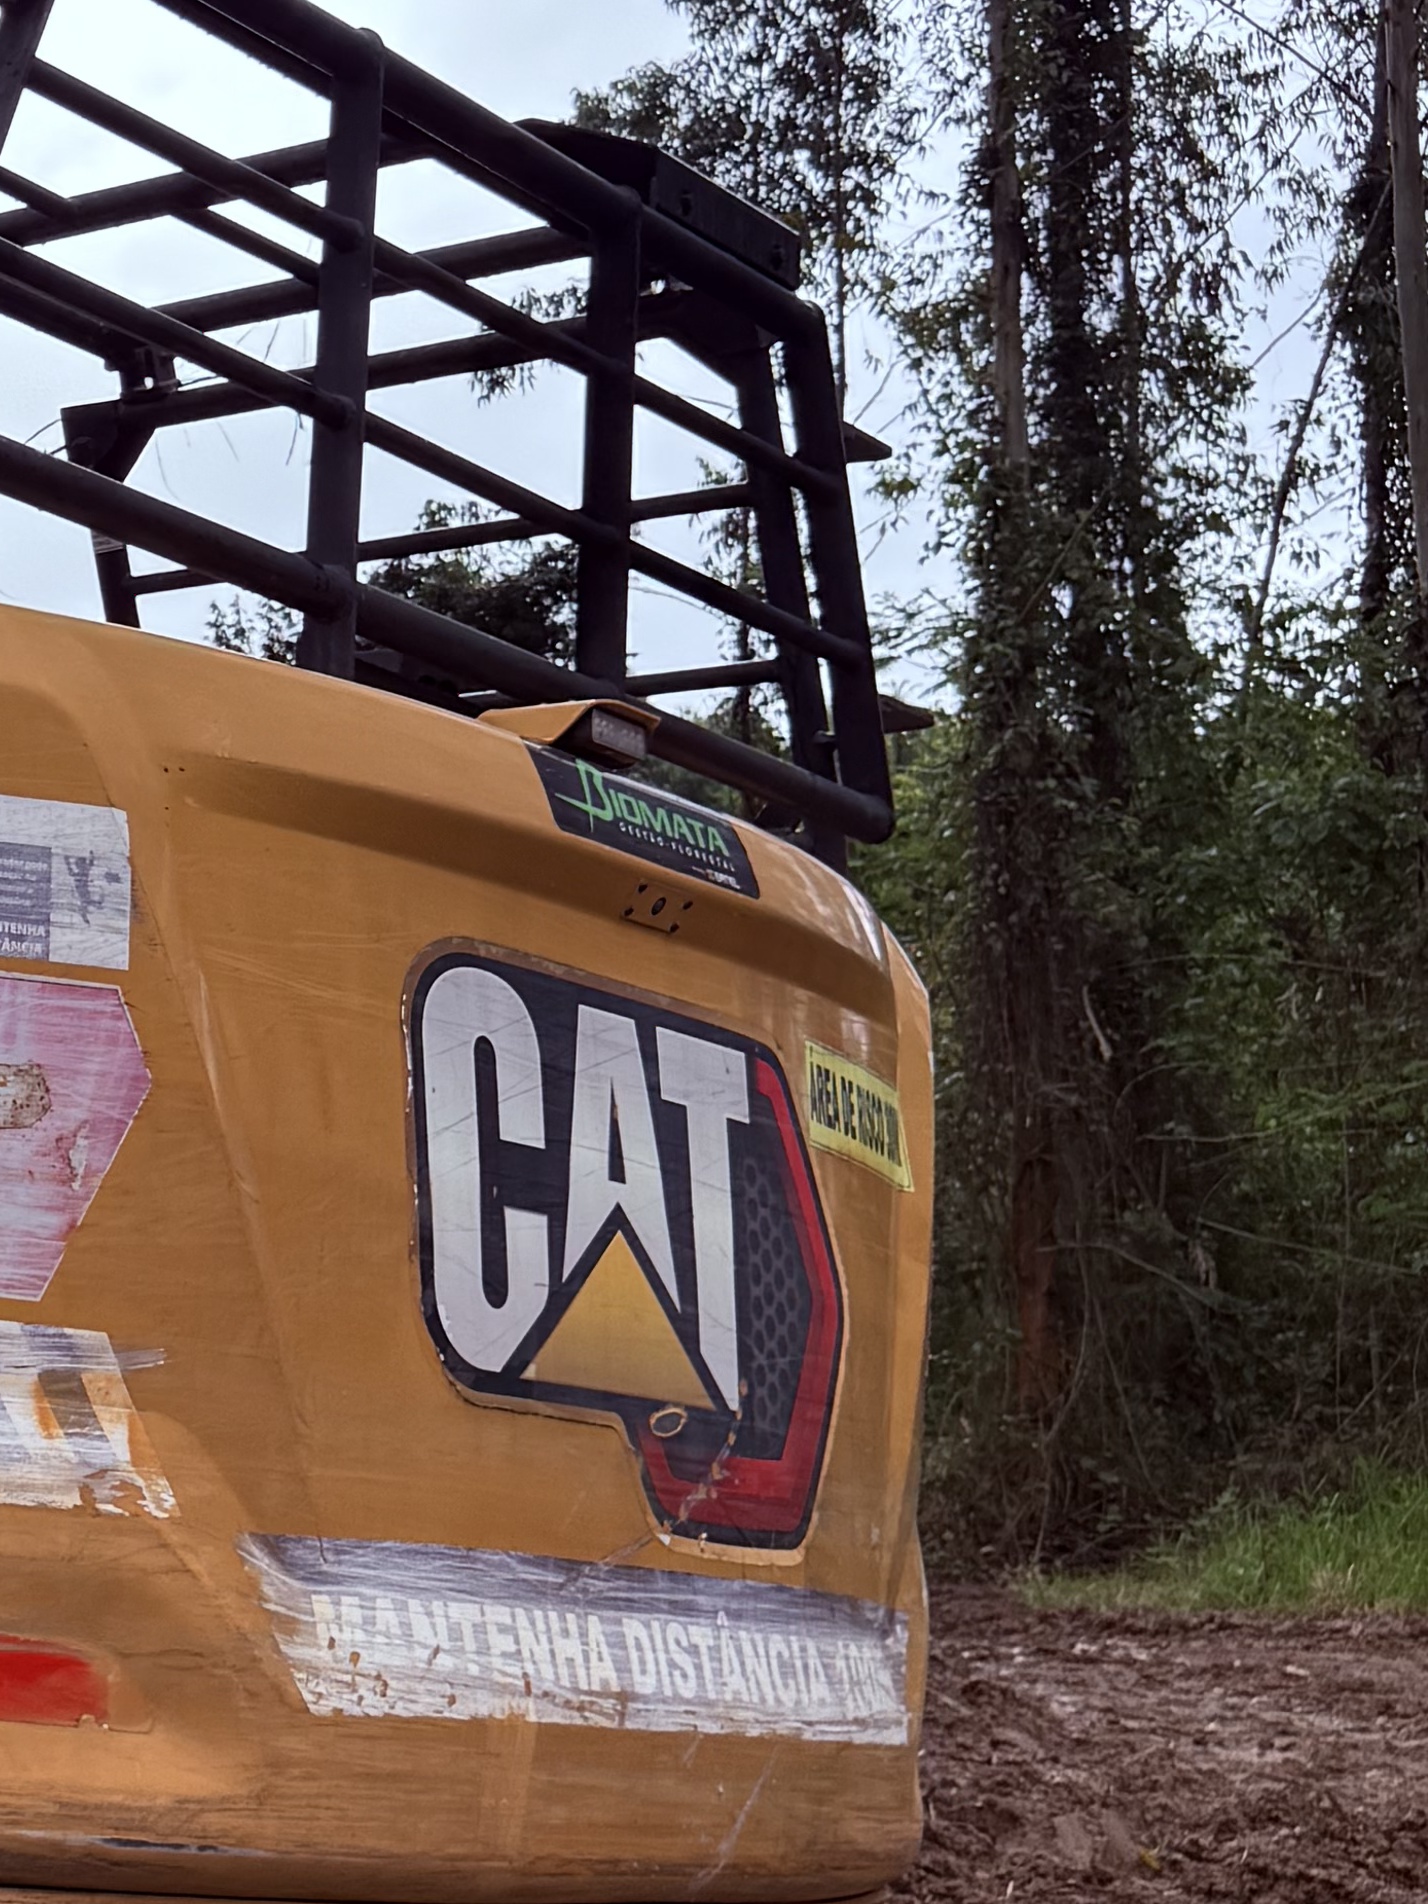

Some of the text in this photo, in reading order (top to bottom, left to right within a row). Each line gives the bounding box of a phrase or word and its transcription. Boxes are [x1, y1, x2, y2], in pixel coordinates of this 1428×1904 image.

[840, 1075, 857, 1141] DE
[421, 966, 751, 1412] CAT
[622, 1610, 831, 1708] DISTÂNCIA
